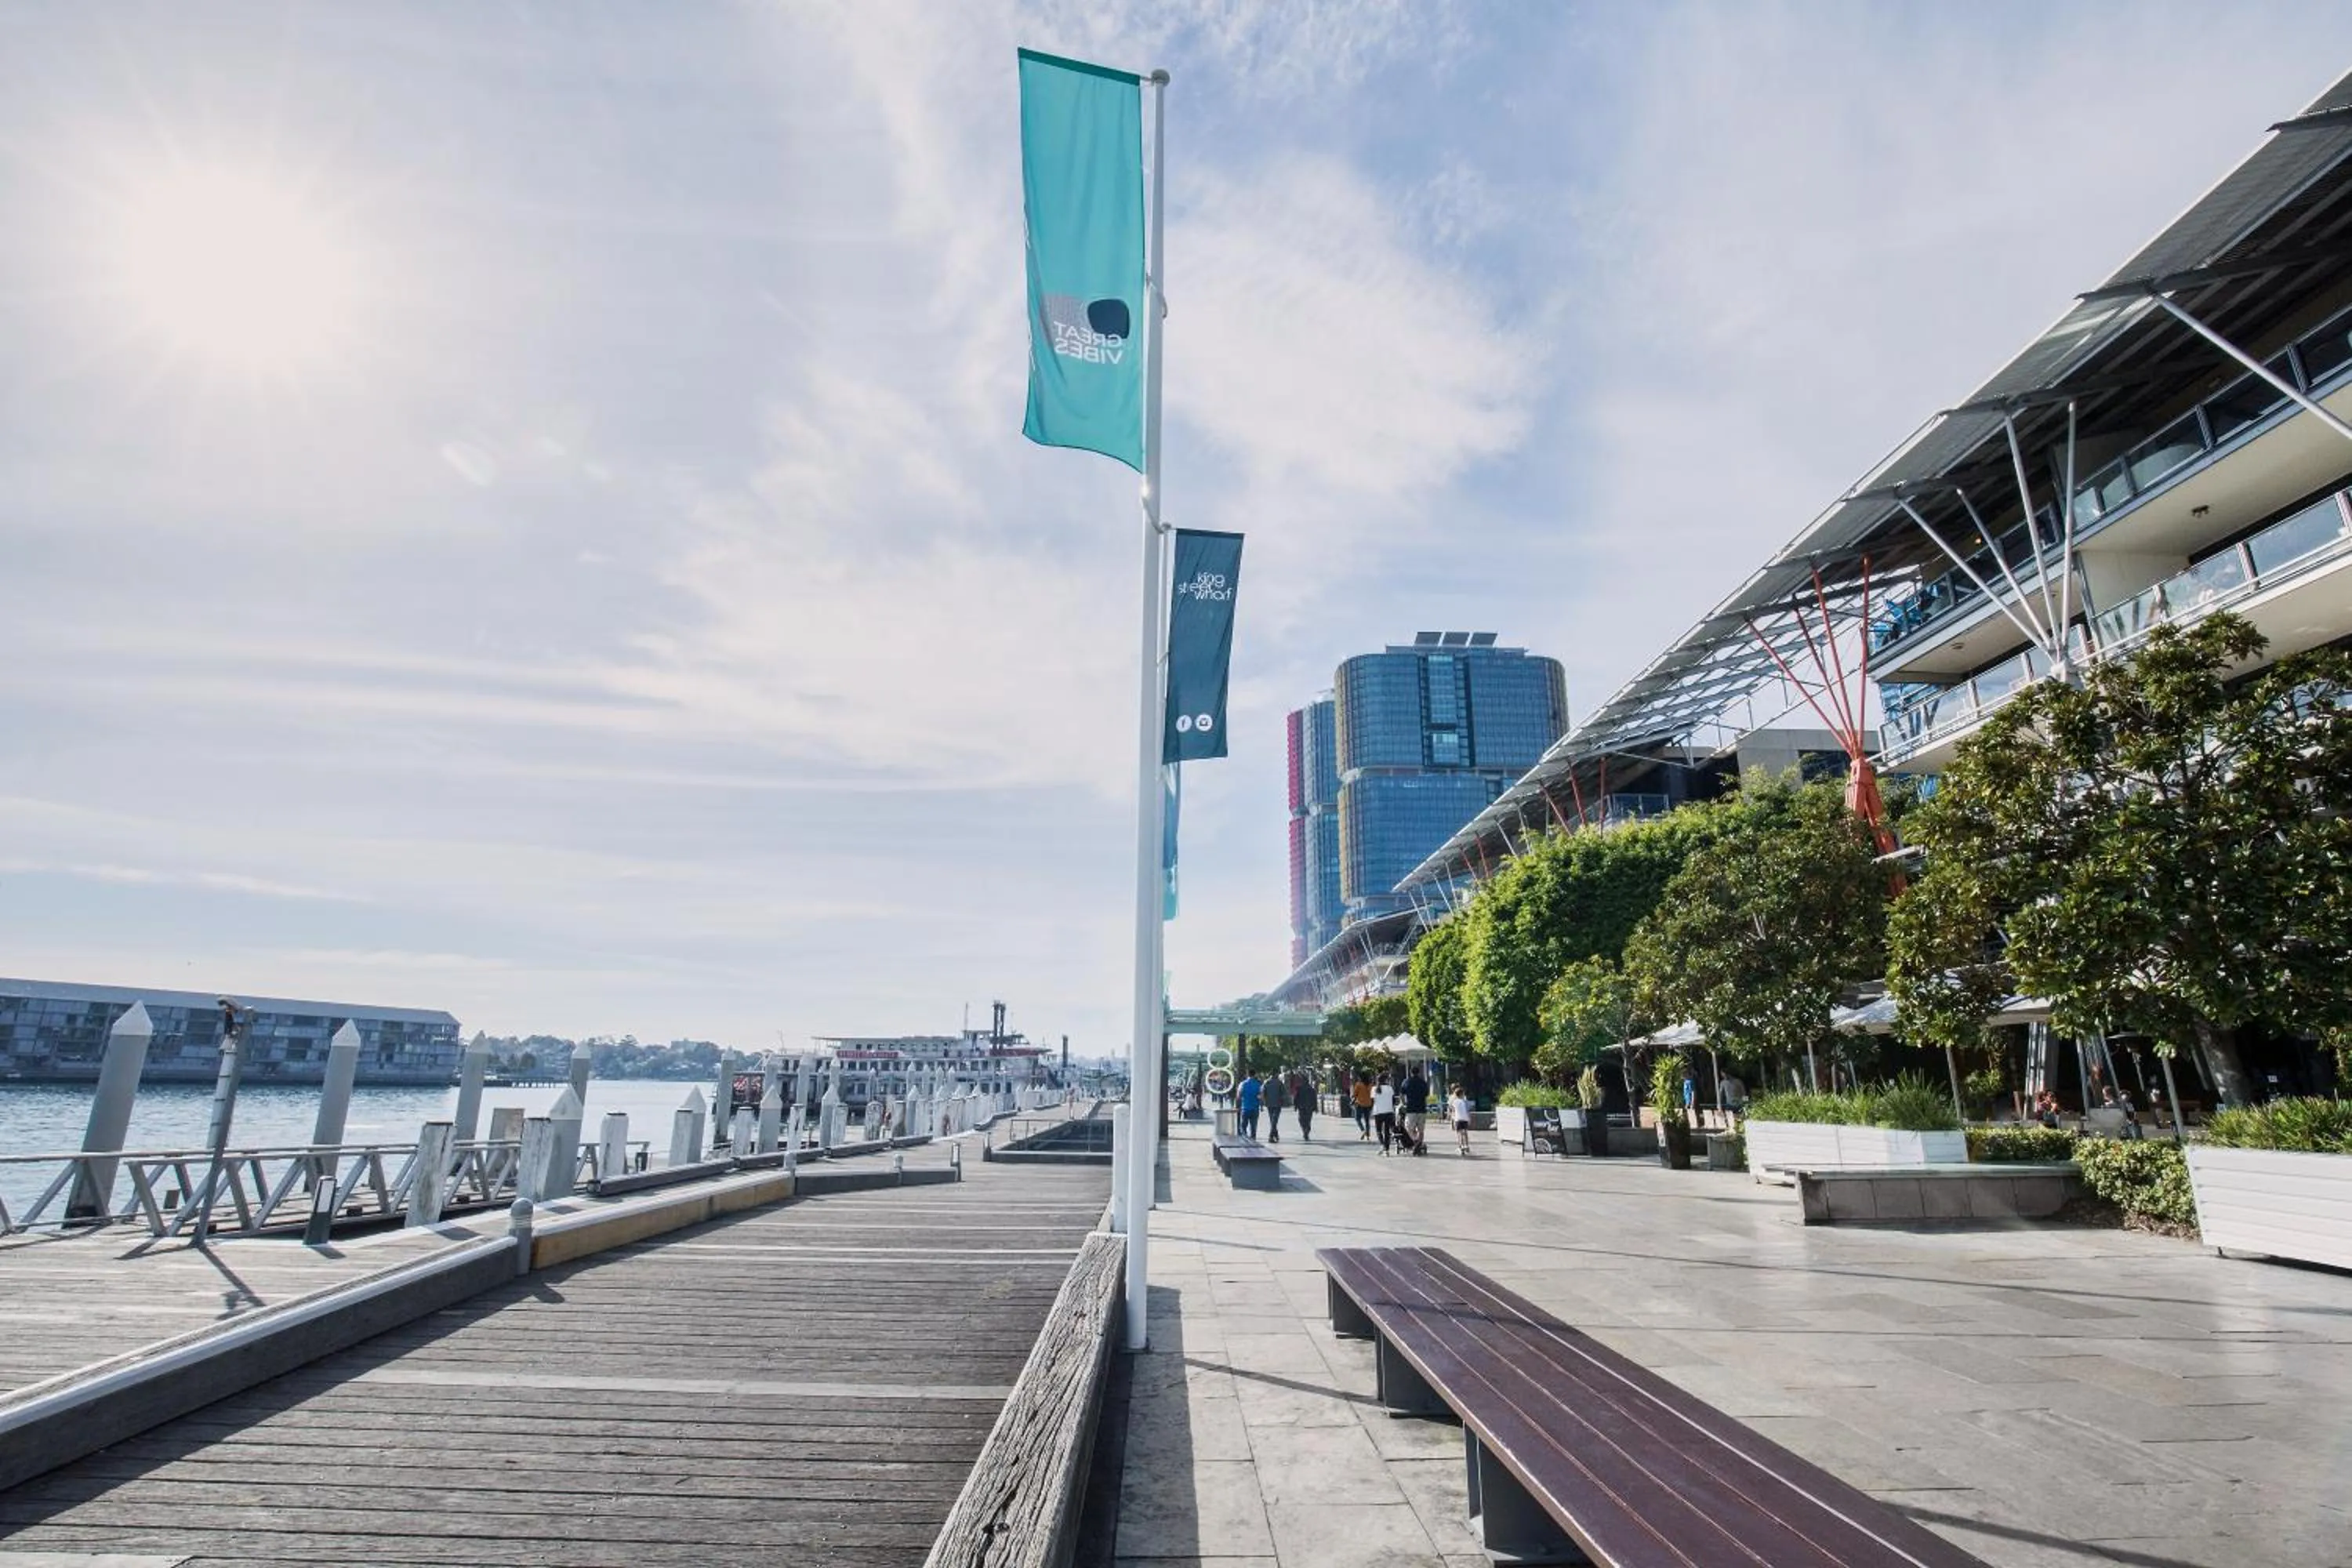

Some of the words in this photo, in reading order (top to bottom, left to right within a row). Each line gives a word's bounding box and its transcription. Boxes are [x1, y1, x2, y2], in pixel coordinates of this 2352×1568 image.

[1178, 582, 1213, 593] steet
[1197, 572, 1225, 588] king
[1194, 586, 1233, 601] wharf
